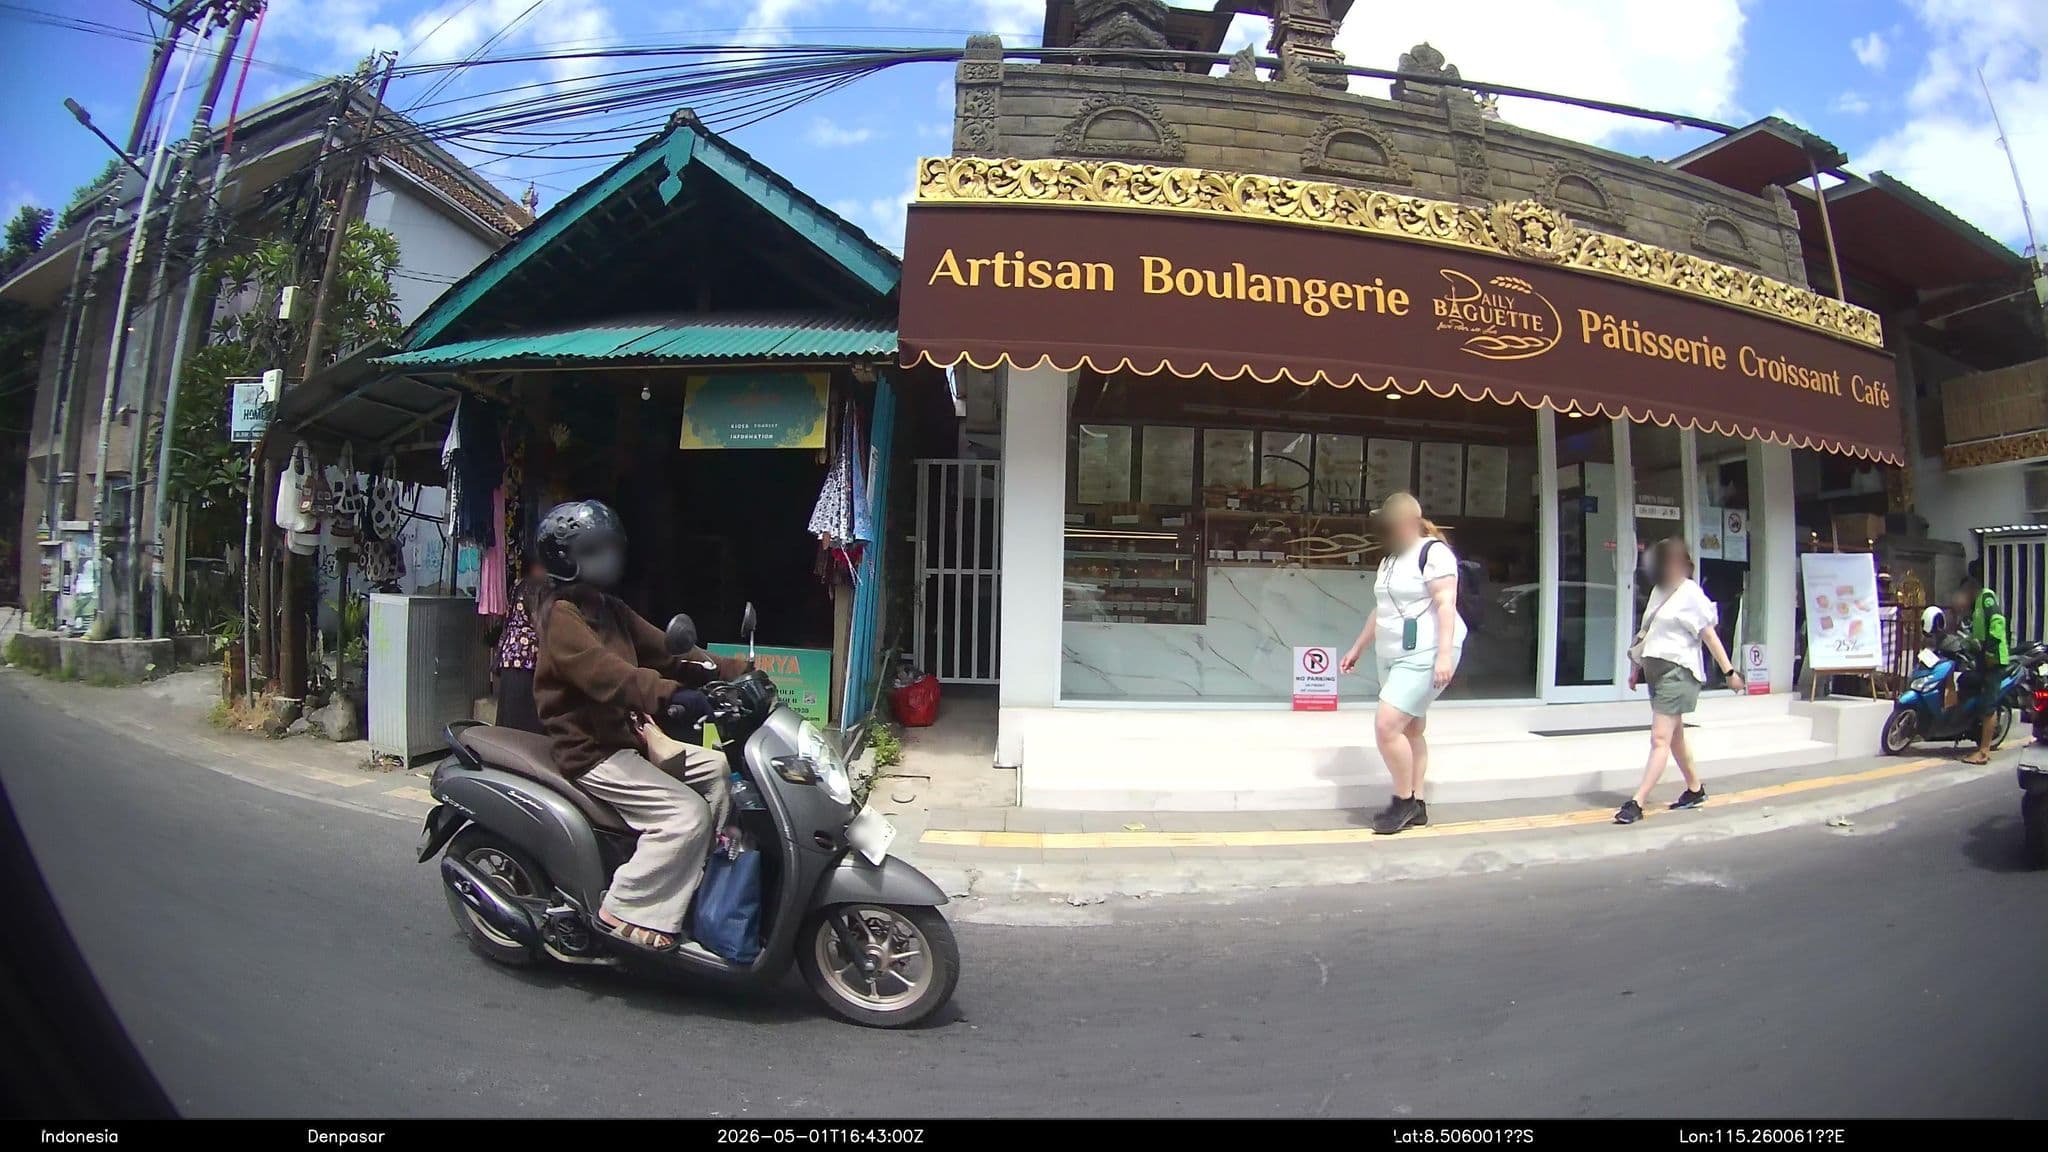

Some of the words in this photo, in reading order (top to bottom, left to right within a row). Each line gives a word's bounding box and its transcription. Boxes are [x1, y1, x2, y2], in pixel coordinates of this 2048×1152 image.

[928, 248, 1115, 292] Artisan
[1139, 255, 1410, 317] Boulangerie
[1439, 268, 1515, 310] DAILY
[1432, 297, 1544, 332] BAGUETTE
[1577, 308, 1727, 370] Pâtisserie
[1739, 346, 1842, 396] Croissant
[1851, 375, 1890, 409] Café
